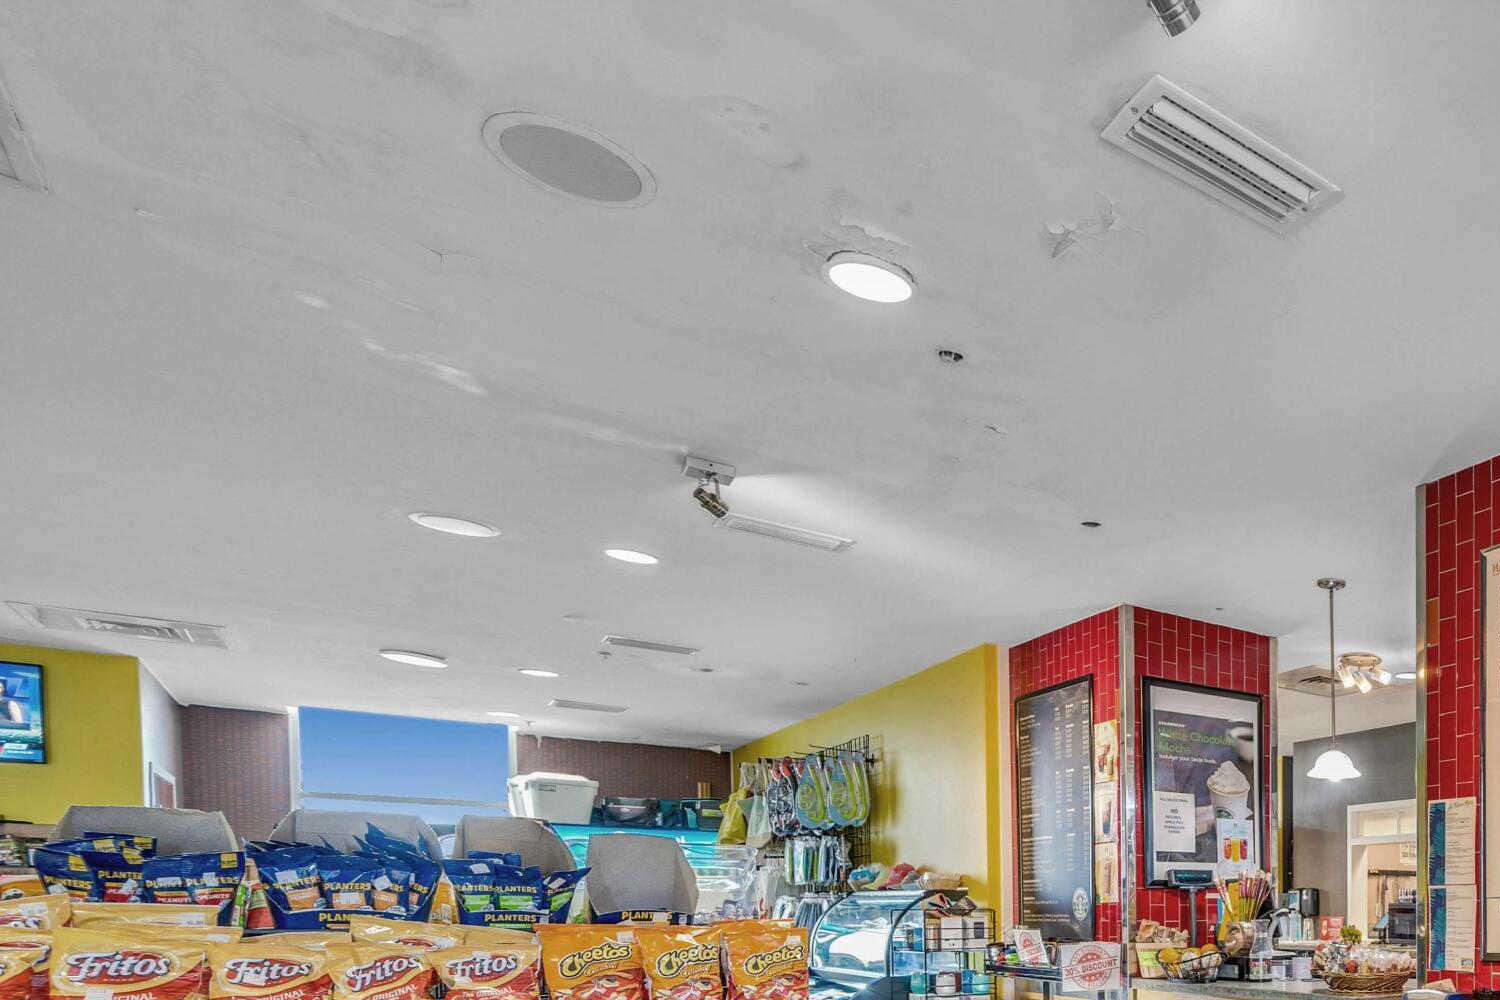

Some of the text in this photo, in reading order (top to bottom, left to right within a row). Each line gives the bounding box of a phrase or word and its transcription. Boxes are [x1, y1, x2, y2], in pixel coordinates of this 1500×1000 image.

[1159, 744, 1191, 753] Mocha
[67, 951, 170, 981] Fritos
[225, 958, 311, 984] Fritos
[346, 956, 420, 991] Fritos
[446, 955, 517, 979] Fritos
[560, 944, 631, 978] Cheetos
[658, 945, 719, 977] Cheetos
[745, 946, 804, 975] Cheetos
[1082, 959, 1117, 972] DISCOUNT
[373, 985, 418, 1000] ORIGINAL
